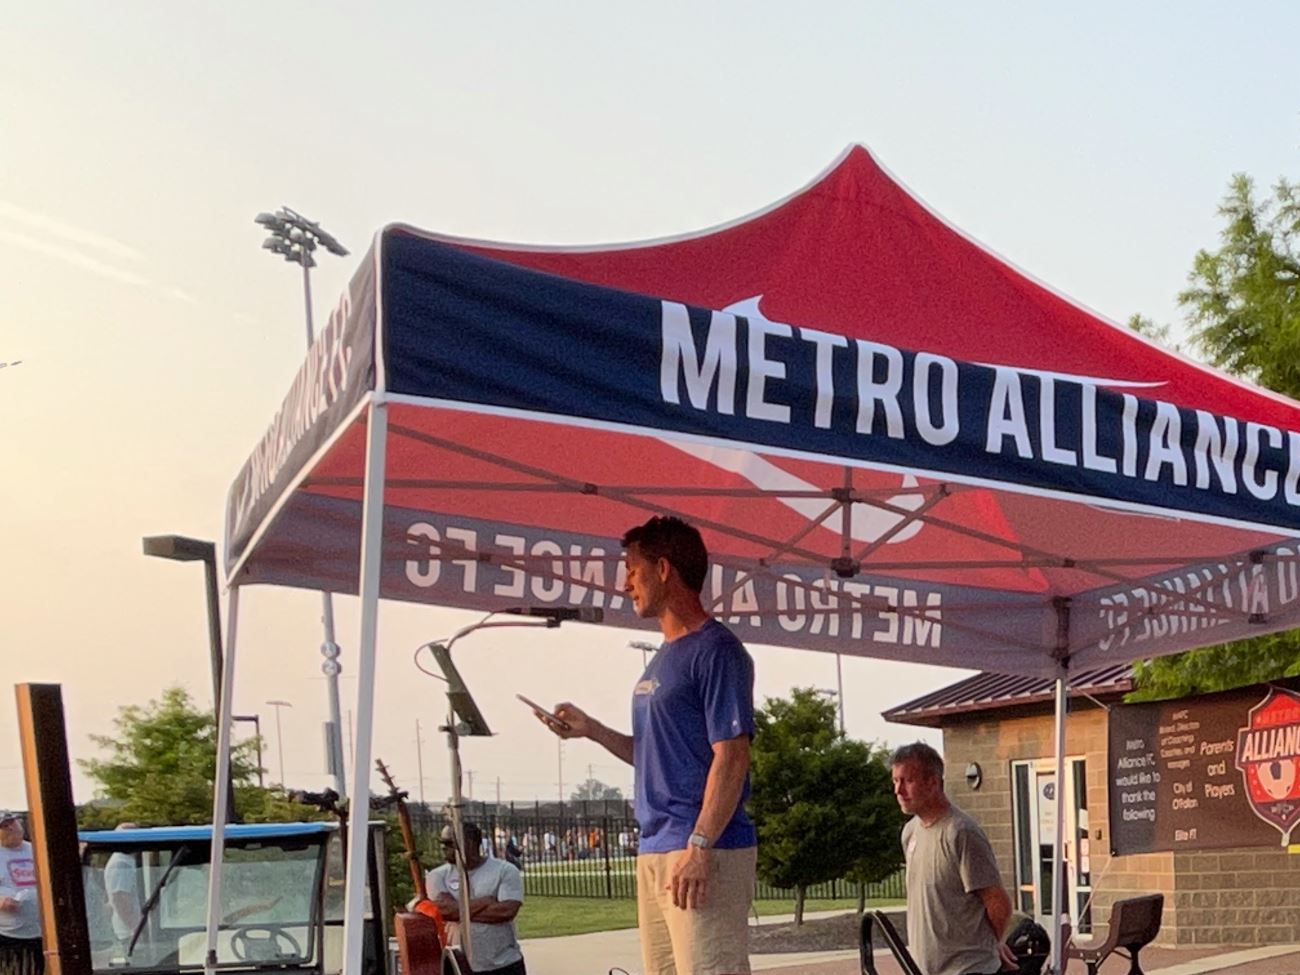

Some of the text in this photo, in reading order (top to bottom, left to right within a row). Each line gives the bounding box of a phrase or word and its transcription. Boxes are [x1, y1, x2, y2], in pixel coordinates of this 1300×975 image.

[660, 299, 959, 446] METRO
[1200, 740, 1235, 755] Parents
[1207, 760, 1226, 776] and
[1205, 783, 1235, 799] Players
